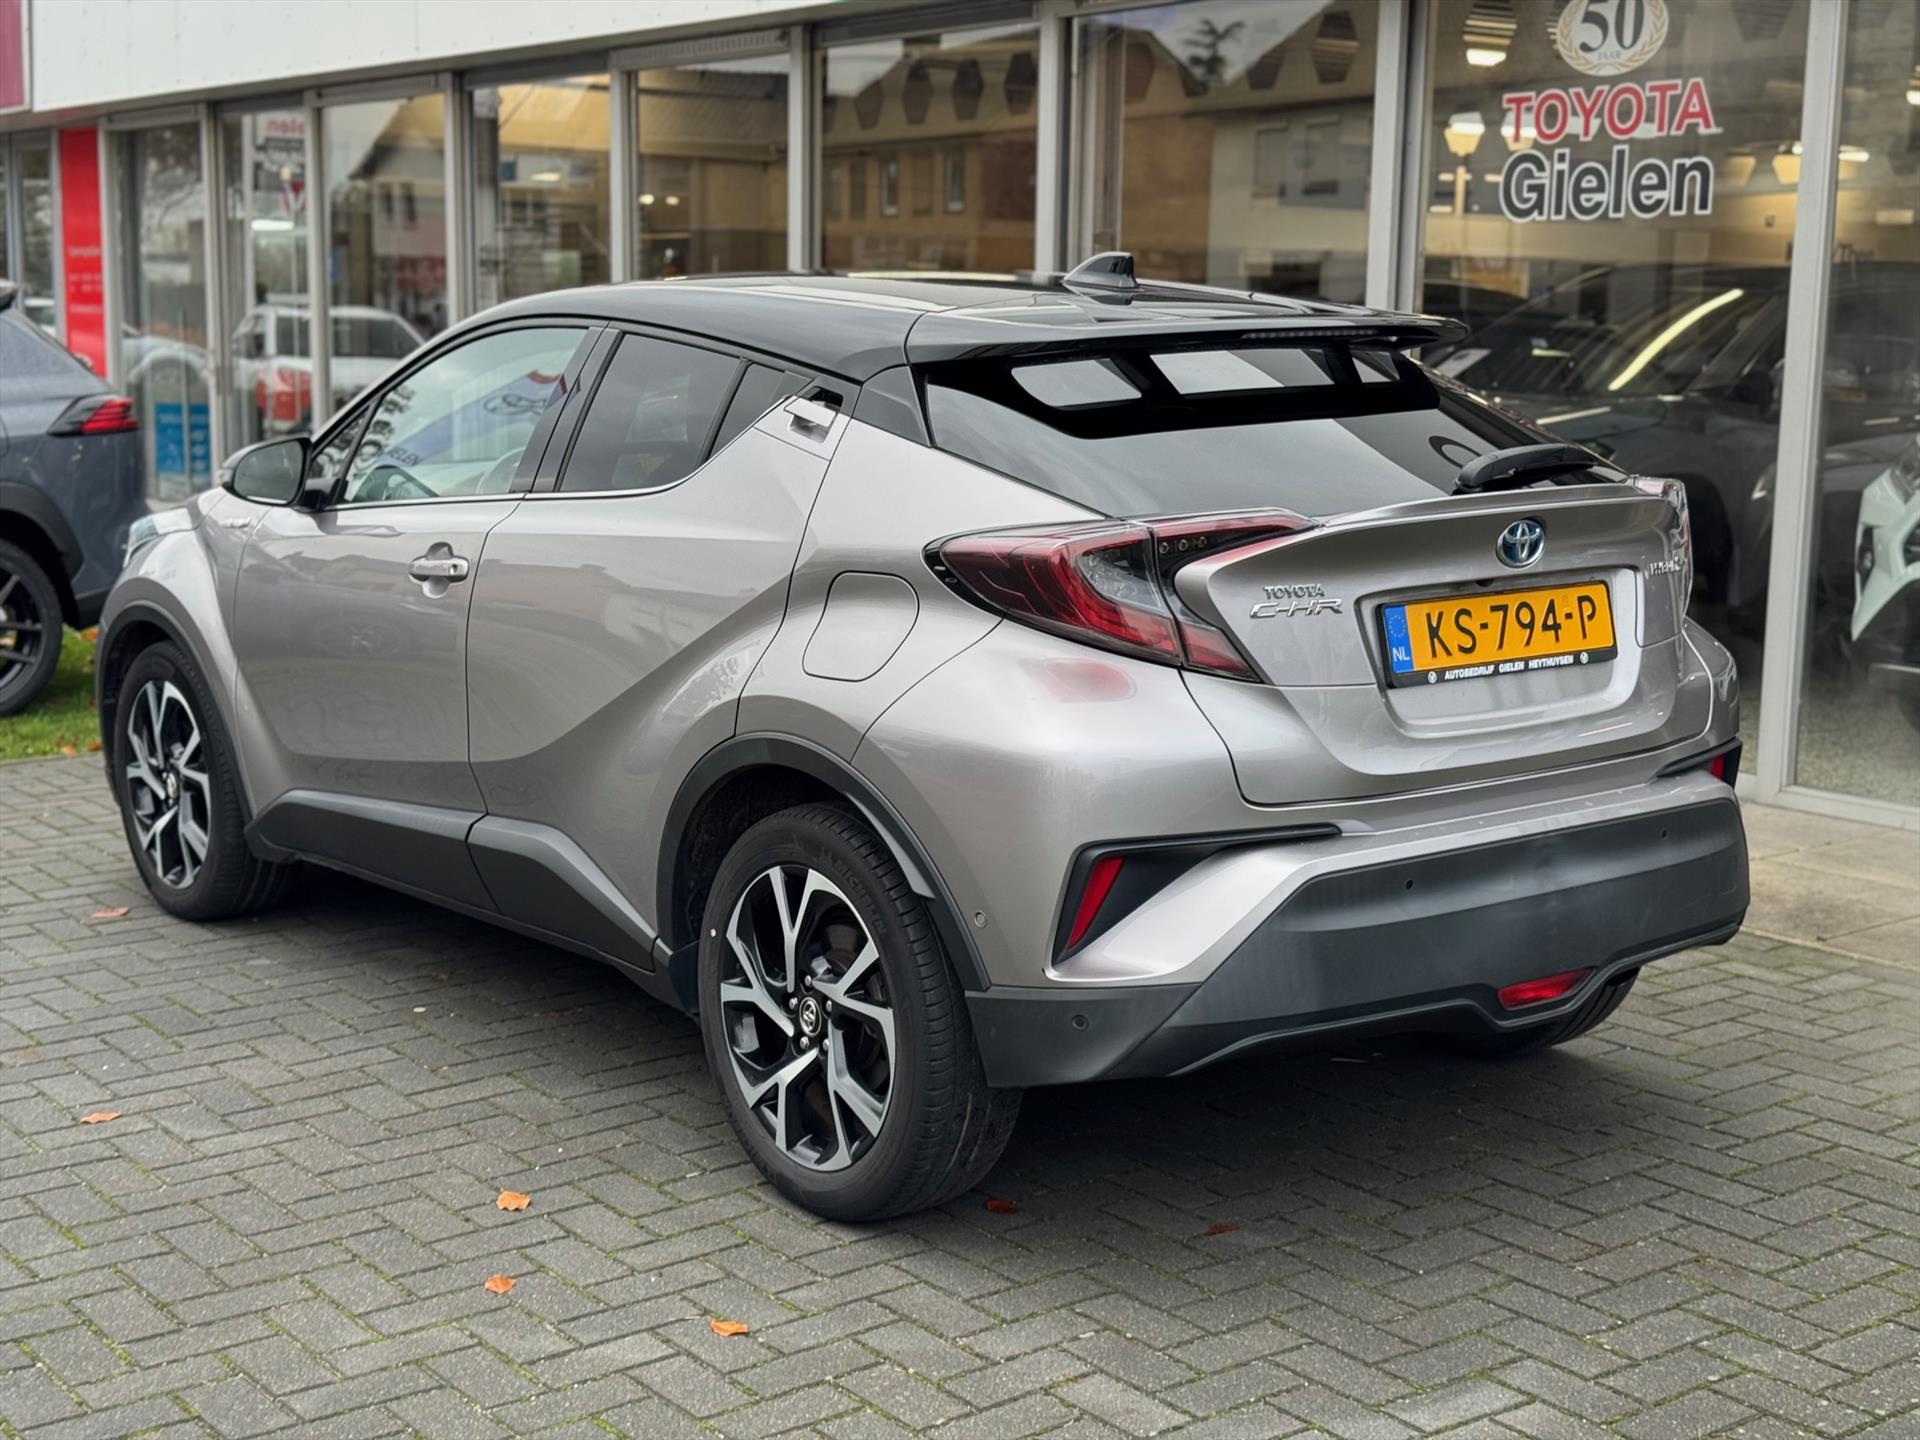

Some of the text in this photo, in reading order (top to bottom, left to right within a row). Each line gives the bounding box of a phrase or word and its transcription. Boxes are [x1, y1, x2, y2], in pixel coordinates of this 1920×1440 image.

[1579, 0, 1645, 53] 50
[1502, 78, 1714, 144] TOYOTA
[1500, 145, 1714, 222] Gielen
[1263, 583, 1325, 600] TOYOTA
[1425, 594, 1598, 660] KS-794-P
[1393, 647, 1411, 661] NL
[1444, 655, 1574, 681] AUTOBEDRIJF GIELEN HEYTHUYSEN
